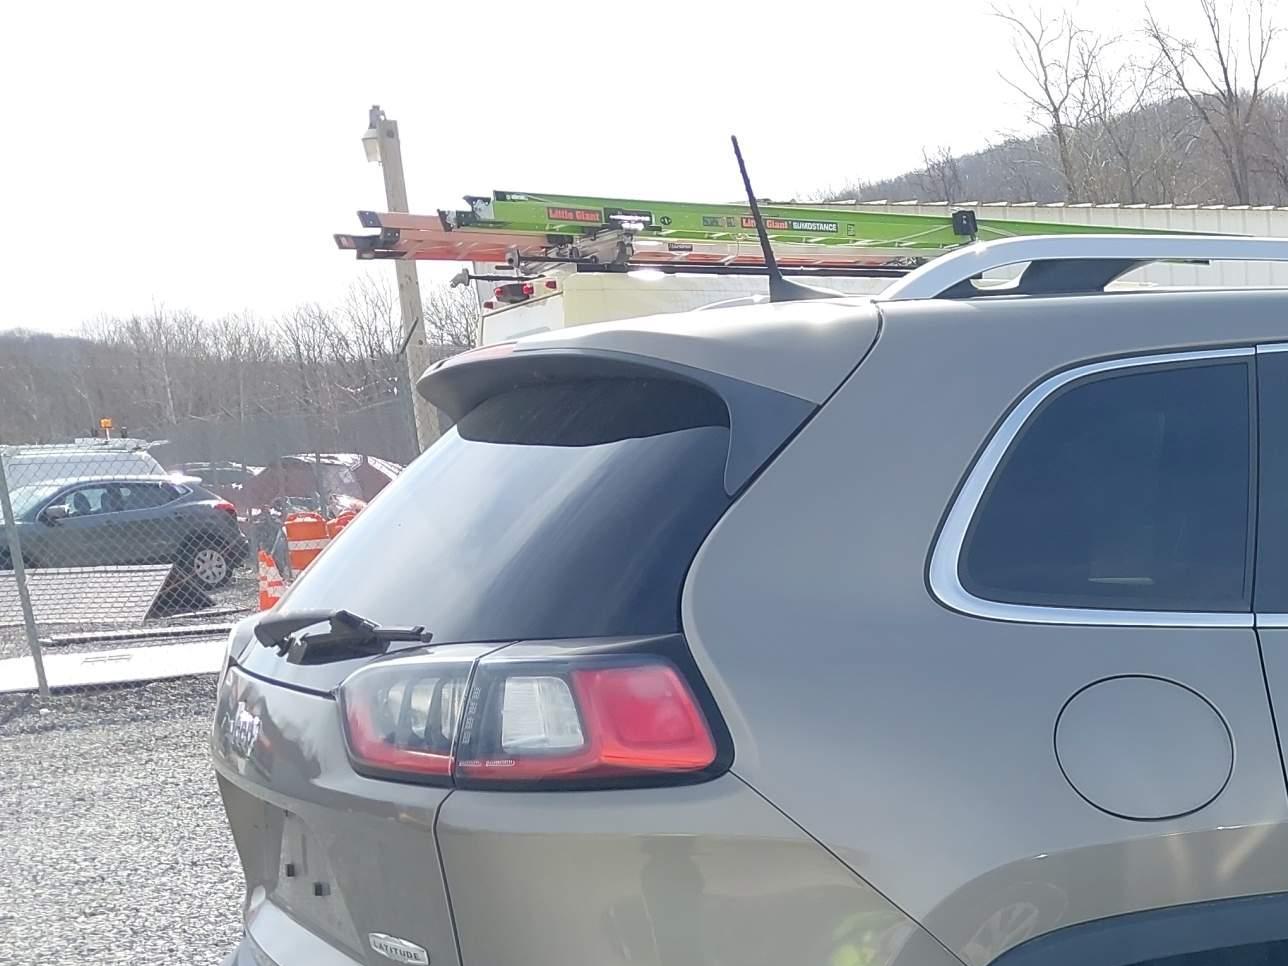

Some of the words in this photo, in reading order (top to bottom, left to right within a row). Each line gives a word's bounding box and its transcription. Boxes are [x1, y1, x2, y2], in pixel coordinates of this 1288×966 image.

[549, 207, 573, 220] Little
[575, 210, 600, 221] Giant
[766, 219, 788, 229] Giant
[373, 938, 422, 961] LATITUDE
